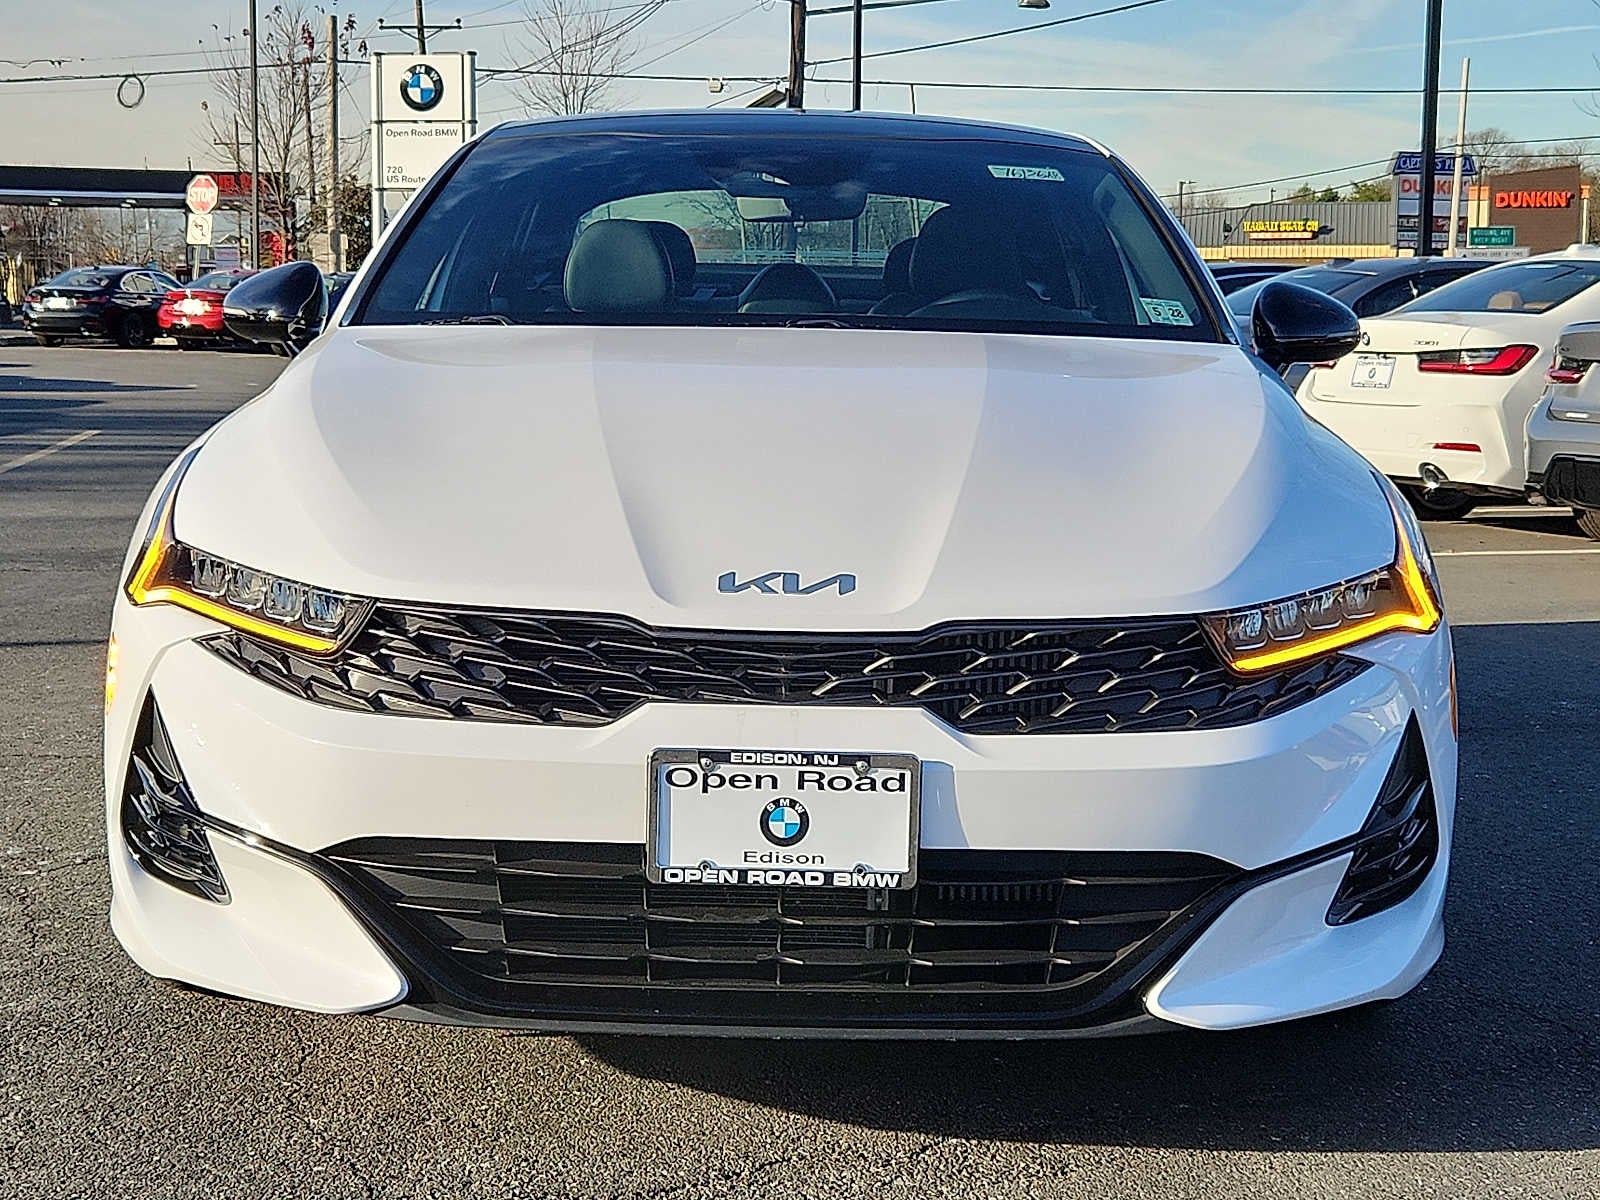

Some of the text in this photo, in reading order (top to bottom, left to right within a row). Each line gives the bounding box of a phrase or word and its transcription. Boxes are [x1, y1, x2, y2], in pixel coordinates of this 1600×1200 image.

[386, 128, 458, 137] Open Road BMW
[387, 166, 403, 174] 720
[386, 175, 426, 184] US Route
[190, 188, 215, 202] STOP
[1495, 190, 1572, 208] DUNKIN'
[1151, 306, 1162, 316] 5
[730, 752, 839, 766] EDISON, NJ
[664, 767, 906, 794] Open Road
[766, 797, 805, 814] BMW
[743, 850, 825, 865] Edison
[664, 868, 900, 888] OPEN ROAD BMW
